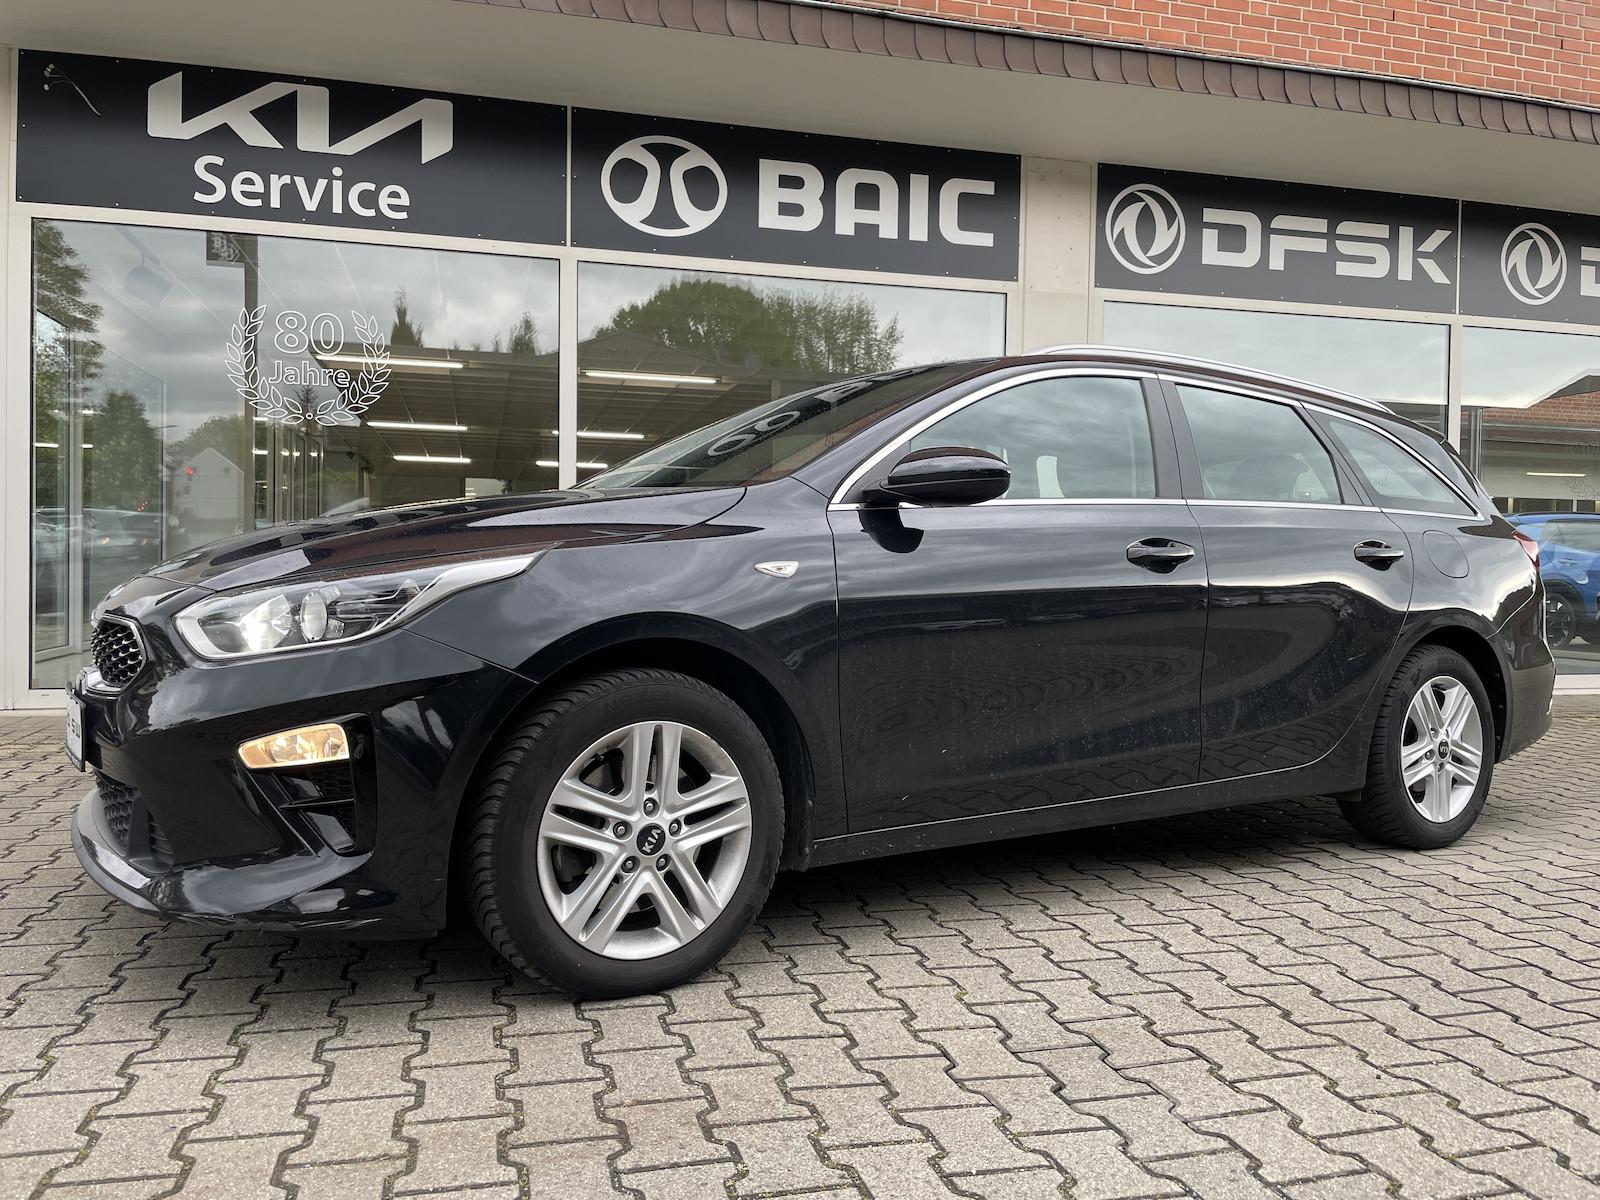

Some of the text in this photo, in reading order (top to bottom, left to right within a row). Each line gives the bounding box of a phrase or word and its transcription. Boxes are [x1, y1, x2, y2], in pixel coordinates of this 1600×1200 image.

[193, 155, 410, 220] Service
[758, 158, 995, 248] BAIC
[1201, 207, 1453, 285] DFSK
[274, 310, 344, 355] 80
[269, 360, 350, 388] Jahre
[642, 829, 662, 853] KIA
